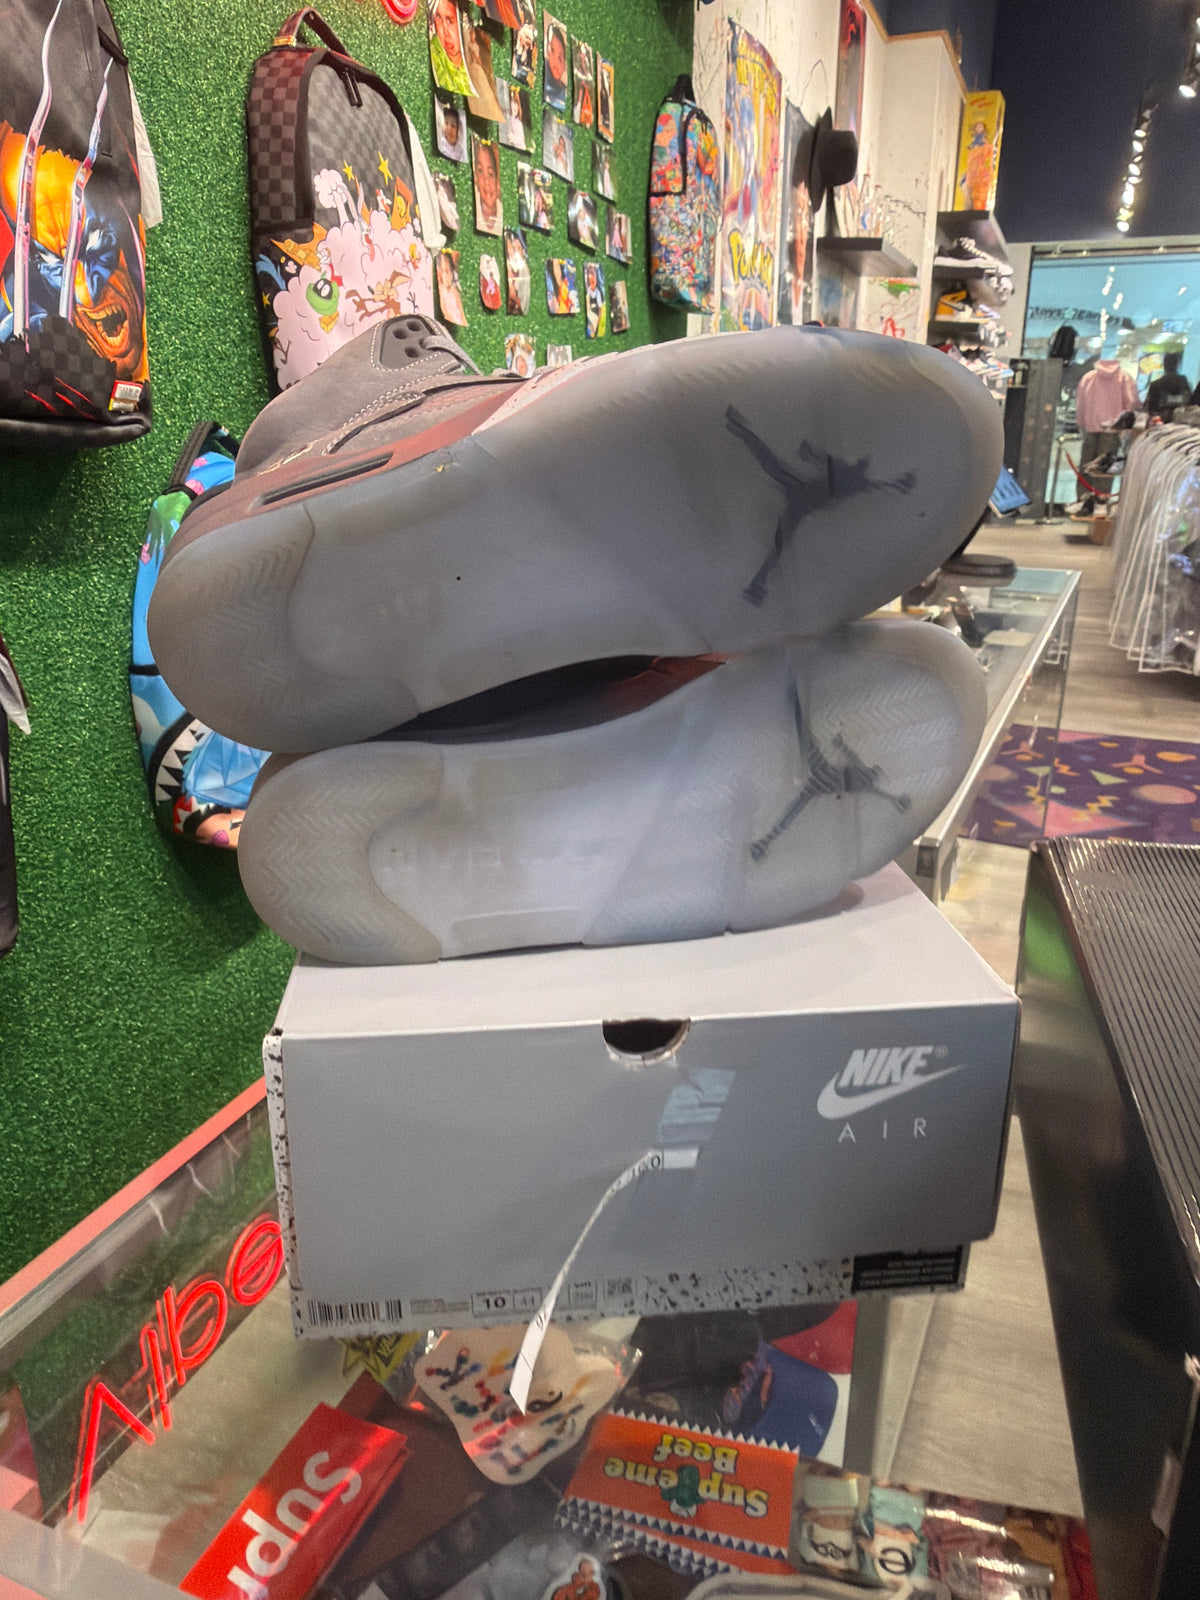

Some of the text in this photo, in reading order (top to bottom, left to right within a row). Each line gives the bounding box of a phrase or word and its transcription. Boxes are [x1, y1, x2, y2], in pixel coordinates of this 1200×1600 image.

[837, 1044, 934, 1088] NIKE
[838, 1117, 927, 1144] AIR
[483, 1296, 506, 1309] 10
[652, 1433, 739, 1475] Beef
[603, 1456, 770, 1519] Supeme
